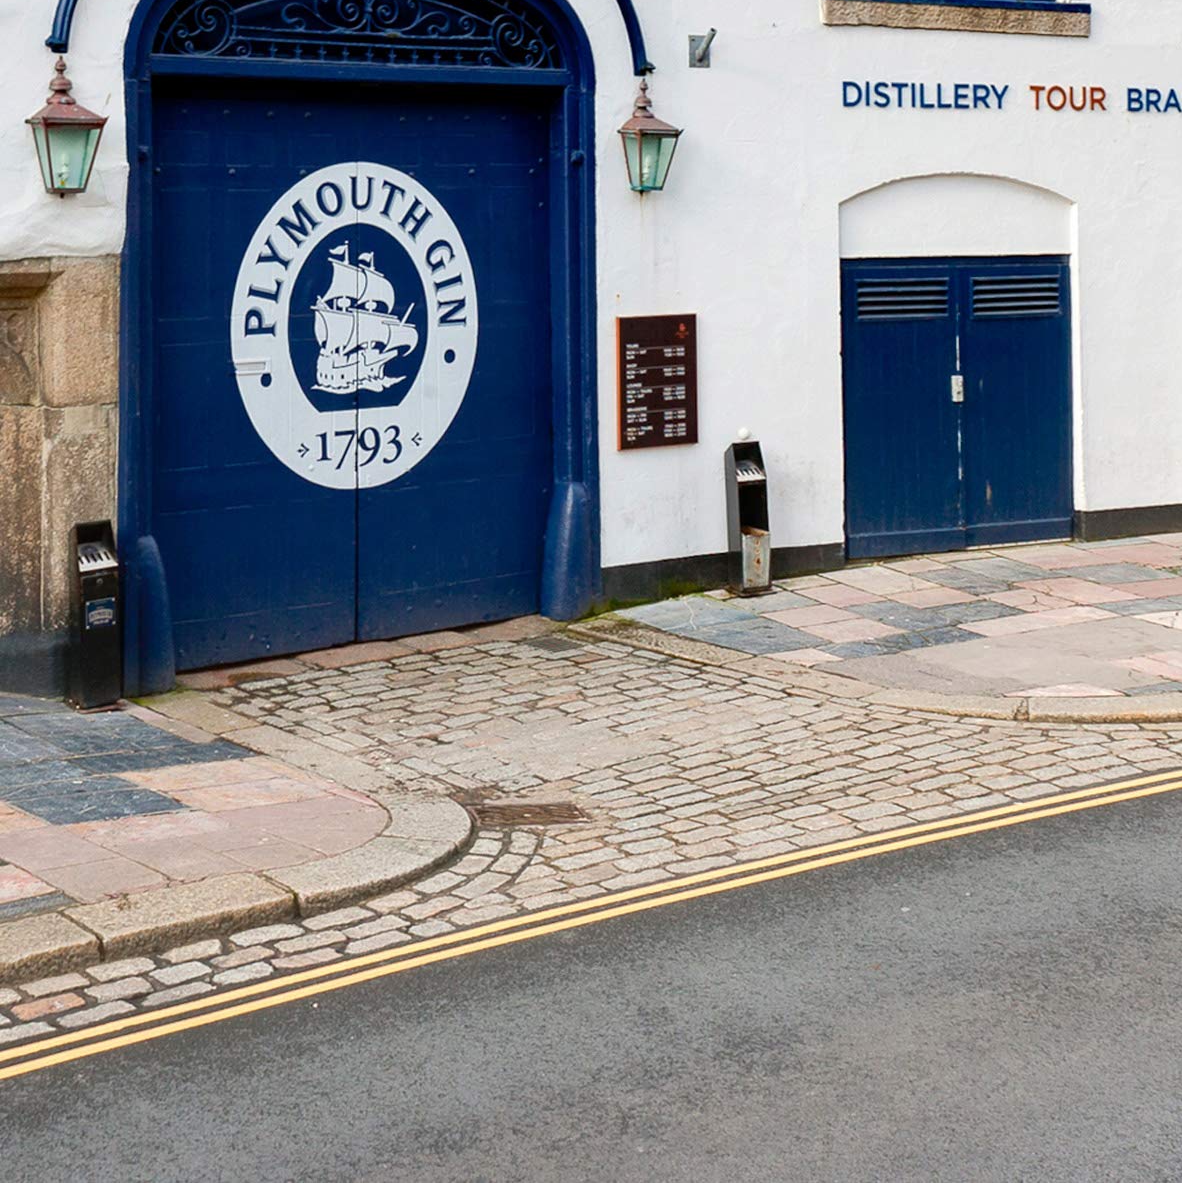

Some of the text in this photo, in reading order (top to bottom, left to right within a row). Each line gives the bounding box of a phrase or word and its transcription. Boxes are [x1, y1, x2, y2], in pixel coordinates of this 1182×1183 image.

[841, 81, 1009, 109] DISTILLERY
[1028, 84, 1107, 111] TOUR
[244, 176, 467, 337] PLYMOUTH GIN
[315, 424, 403, 470] 1793
